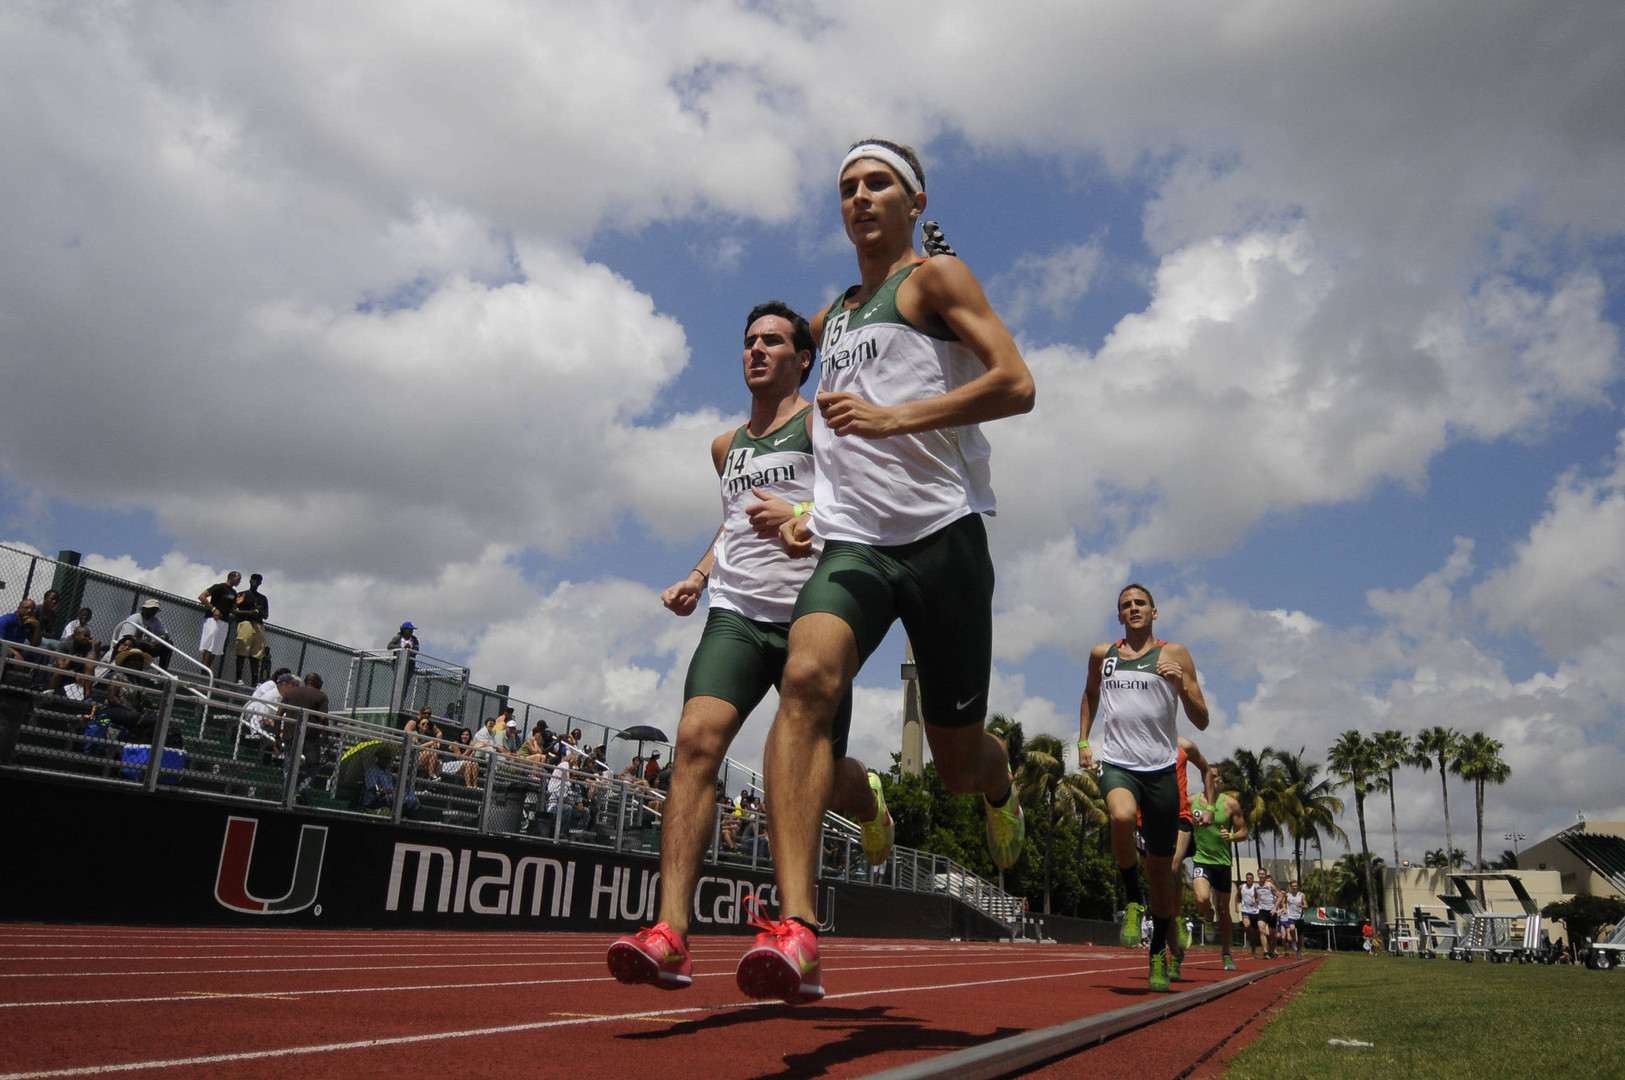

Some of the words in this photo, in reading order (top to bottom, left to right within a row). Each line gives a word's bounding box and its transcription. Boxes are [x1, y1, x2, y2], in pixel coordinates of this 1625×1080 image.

[825, 314, 846, 351] 15
[728, 449, 748, 477] 14
[1103, 658, 1115, 678] 6
